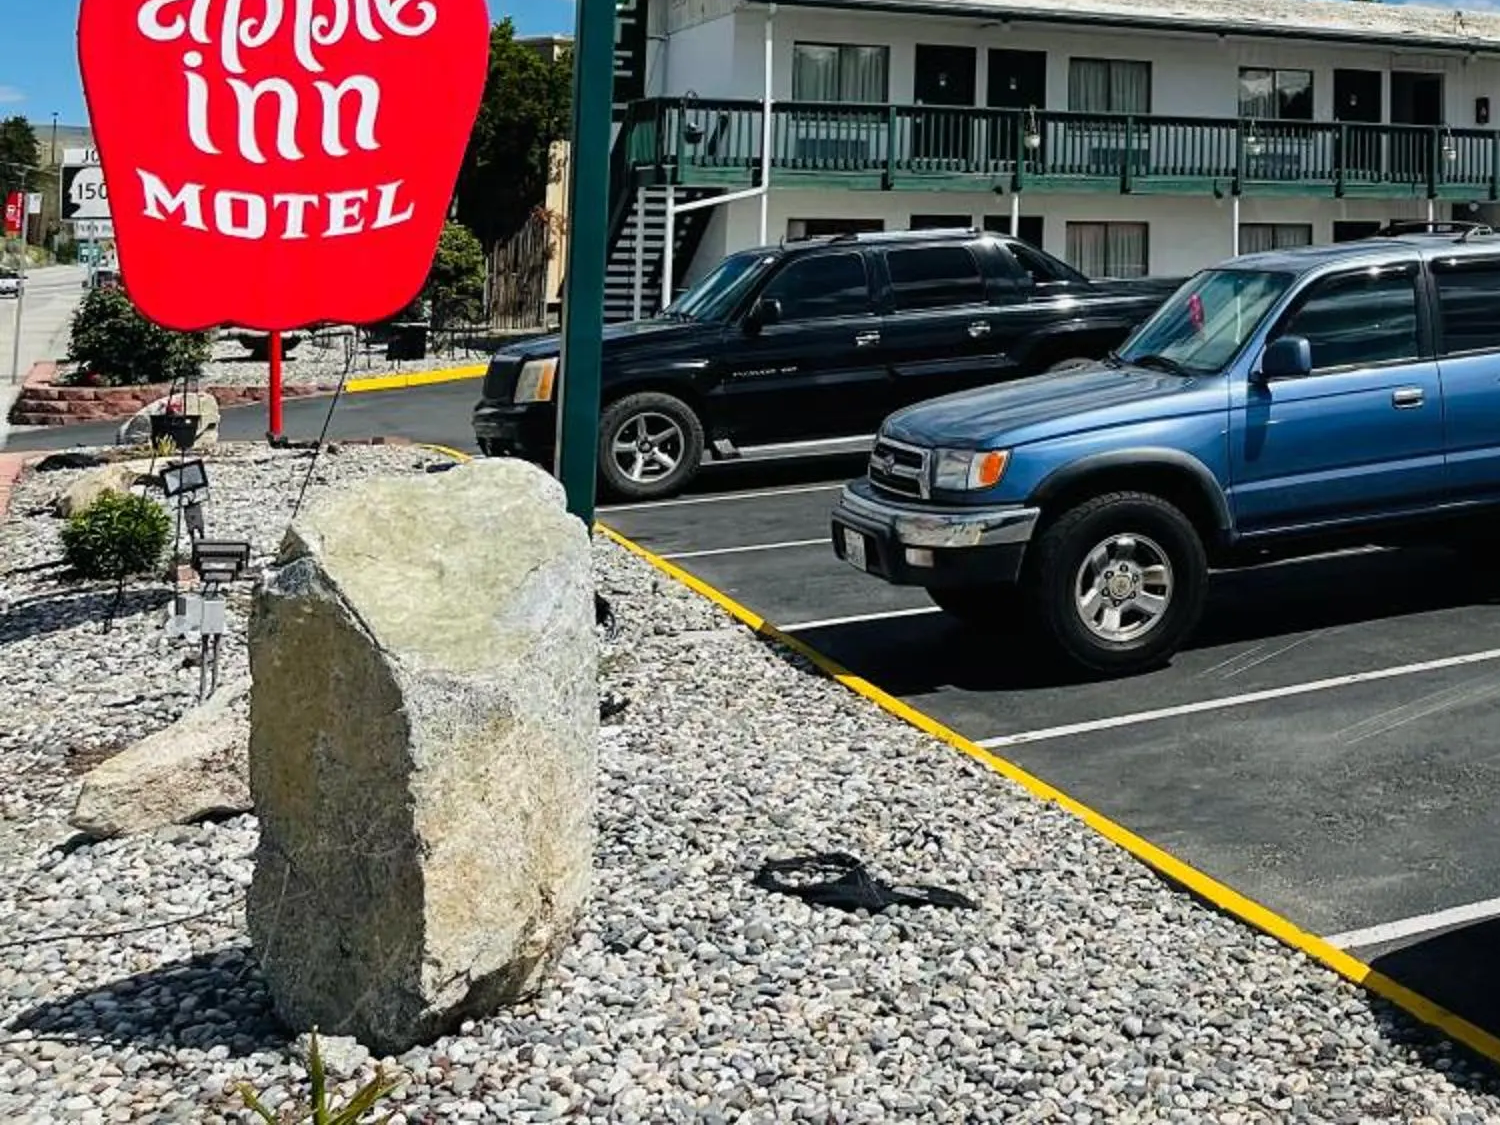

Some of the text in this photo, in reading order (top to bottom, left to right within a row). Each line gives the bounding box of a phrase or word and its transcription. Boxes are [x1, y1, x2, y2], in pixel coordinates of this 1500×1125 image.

[183, 51, 380, 164] inn
[78, 182, 107, 199] 150
[136, 169, 414, 240] MOTEL
